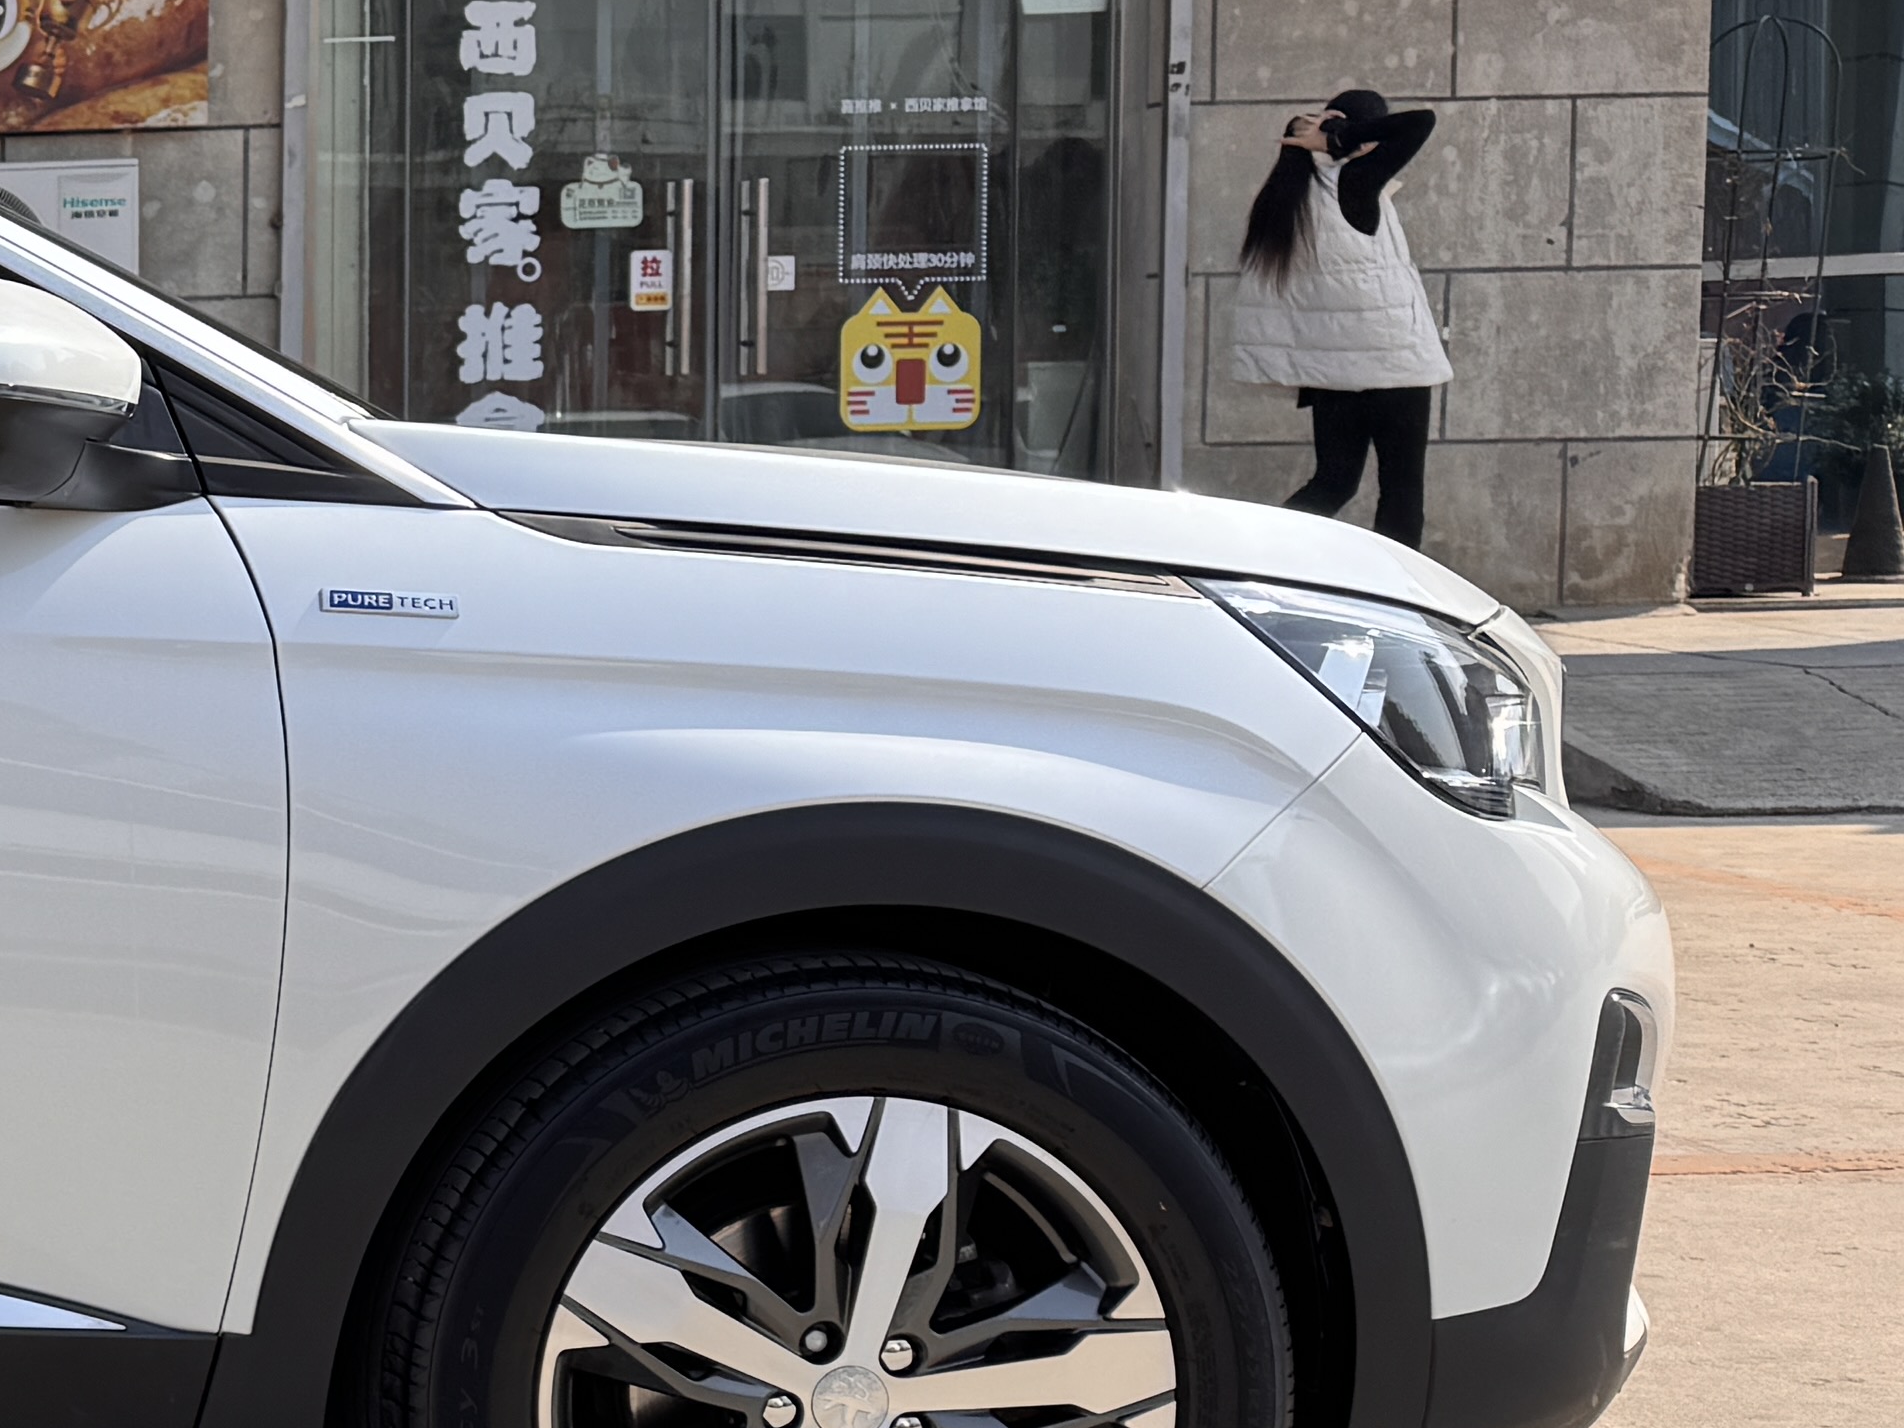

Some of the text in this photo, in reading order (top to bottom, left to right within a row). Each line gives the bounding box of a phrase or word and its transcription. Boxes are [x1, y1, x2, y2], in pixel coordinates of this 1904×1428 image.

[62, 197, 127, 209] Hisense
[641, 256, 663, 278] 拉
[691, 1010, 943, 1080] MICHELIN
